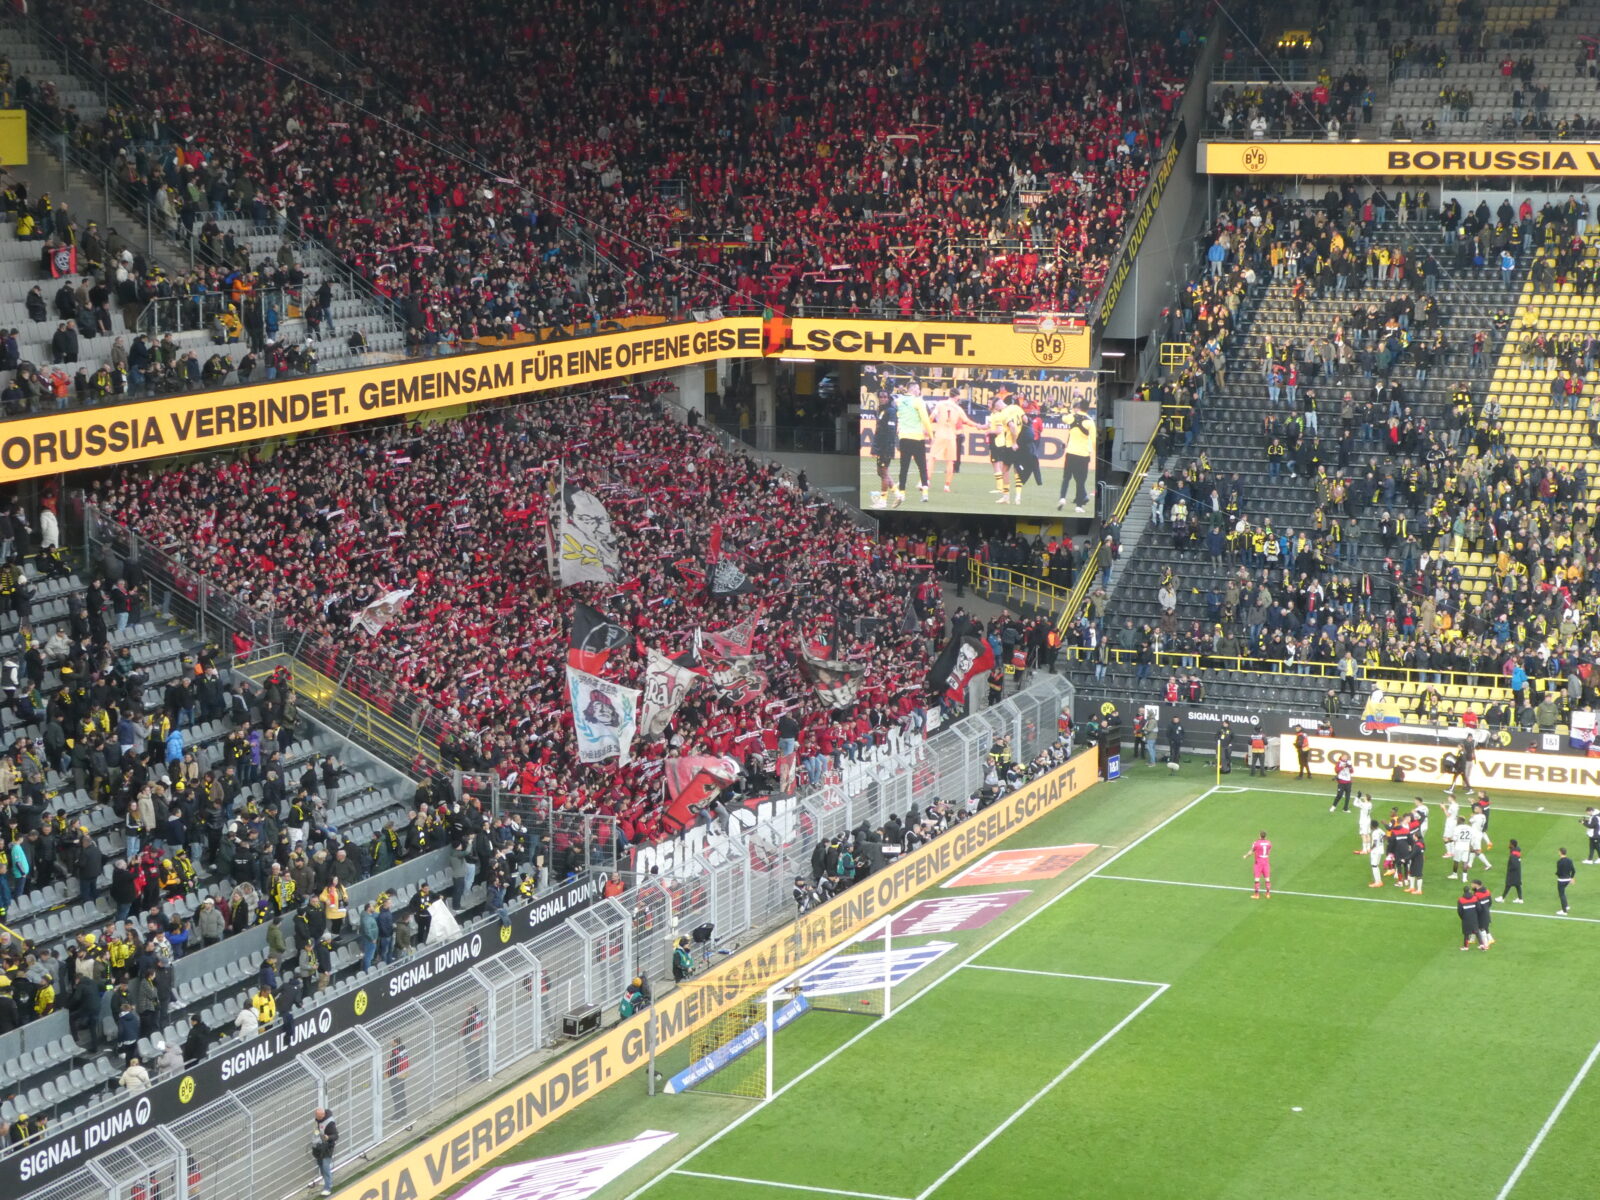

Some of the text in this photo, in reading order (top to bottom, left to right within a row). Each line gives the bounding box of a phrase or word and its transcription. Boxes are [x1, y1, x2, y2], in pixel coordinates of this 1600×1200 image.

[1388, 151, 1578, 170] BORUSSIA
[1101, 144, 1179, 326] SIGNAL IDUNA PARK
[1, 415, 164, 470] ORUSSIA
[171, 387, 349, 441] VERBINDET.
[359, 361, 513, 411] GEMEINSAM
[521, 350, 564, 384] FÜR
[567, 346, 612, 376] EINE
[616, 335, 690, 367] OFFENE
[1018, 384, 1077, 405] TREMONI
[1188, 711, 1220, 722] SIGNAL
[1460, 831, 1470, 840] 22
[529, 899, 567, 927] SIGNAL
[389, 943, 471, 997] SIGNAL IDUNA
[424, 1047, 612, 1187] VERBINDET.
[621, 944, 778, 1065] GEMEINSAM
[783, 916, 827, 965] FÜR
[830, 887, 875, 938] EINE
[878, 842, 951, 907] OFFENE
[953, 768, 1077, 859] GESELLSCHAFT.
[221, 1040, 274, 1081] SIGNAL
[20, 1109, 134, 1181] SIGNAL IDUNA
